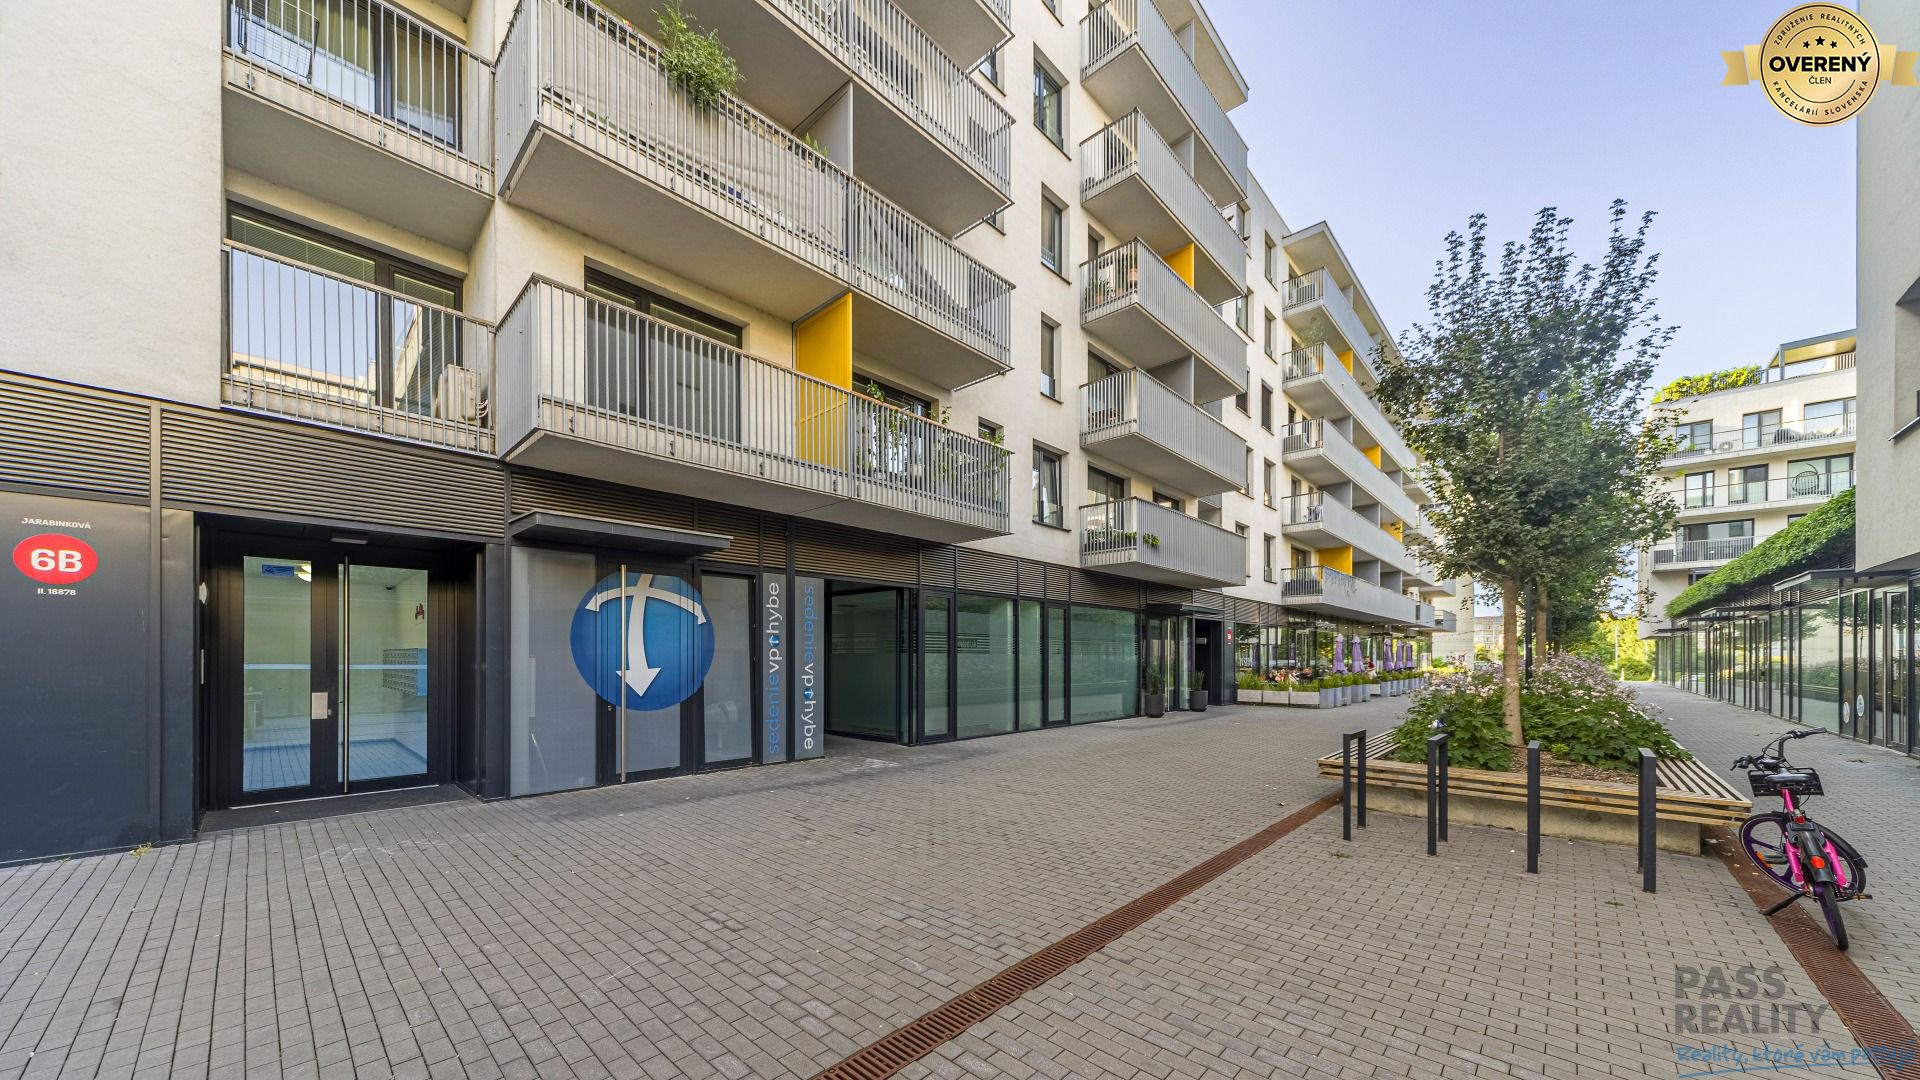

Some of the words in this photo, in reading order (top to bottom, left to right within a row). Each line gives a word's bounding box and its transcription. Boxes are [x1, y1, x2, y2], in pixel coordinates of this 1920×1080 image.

[21, 517, 92, 529] JARABINKOVÁ
[31, 548, 83, 573] 6B
[48, 588, 77, 596] 18878
